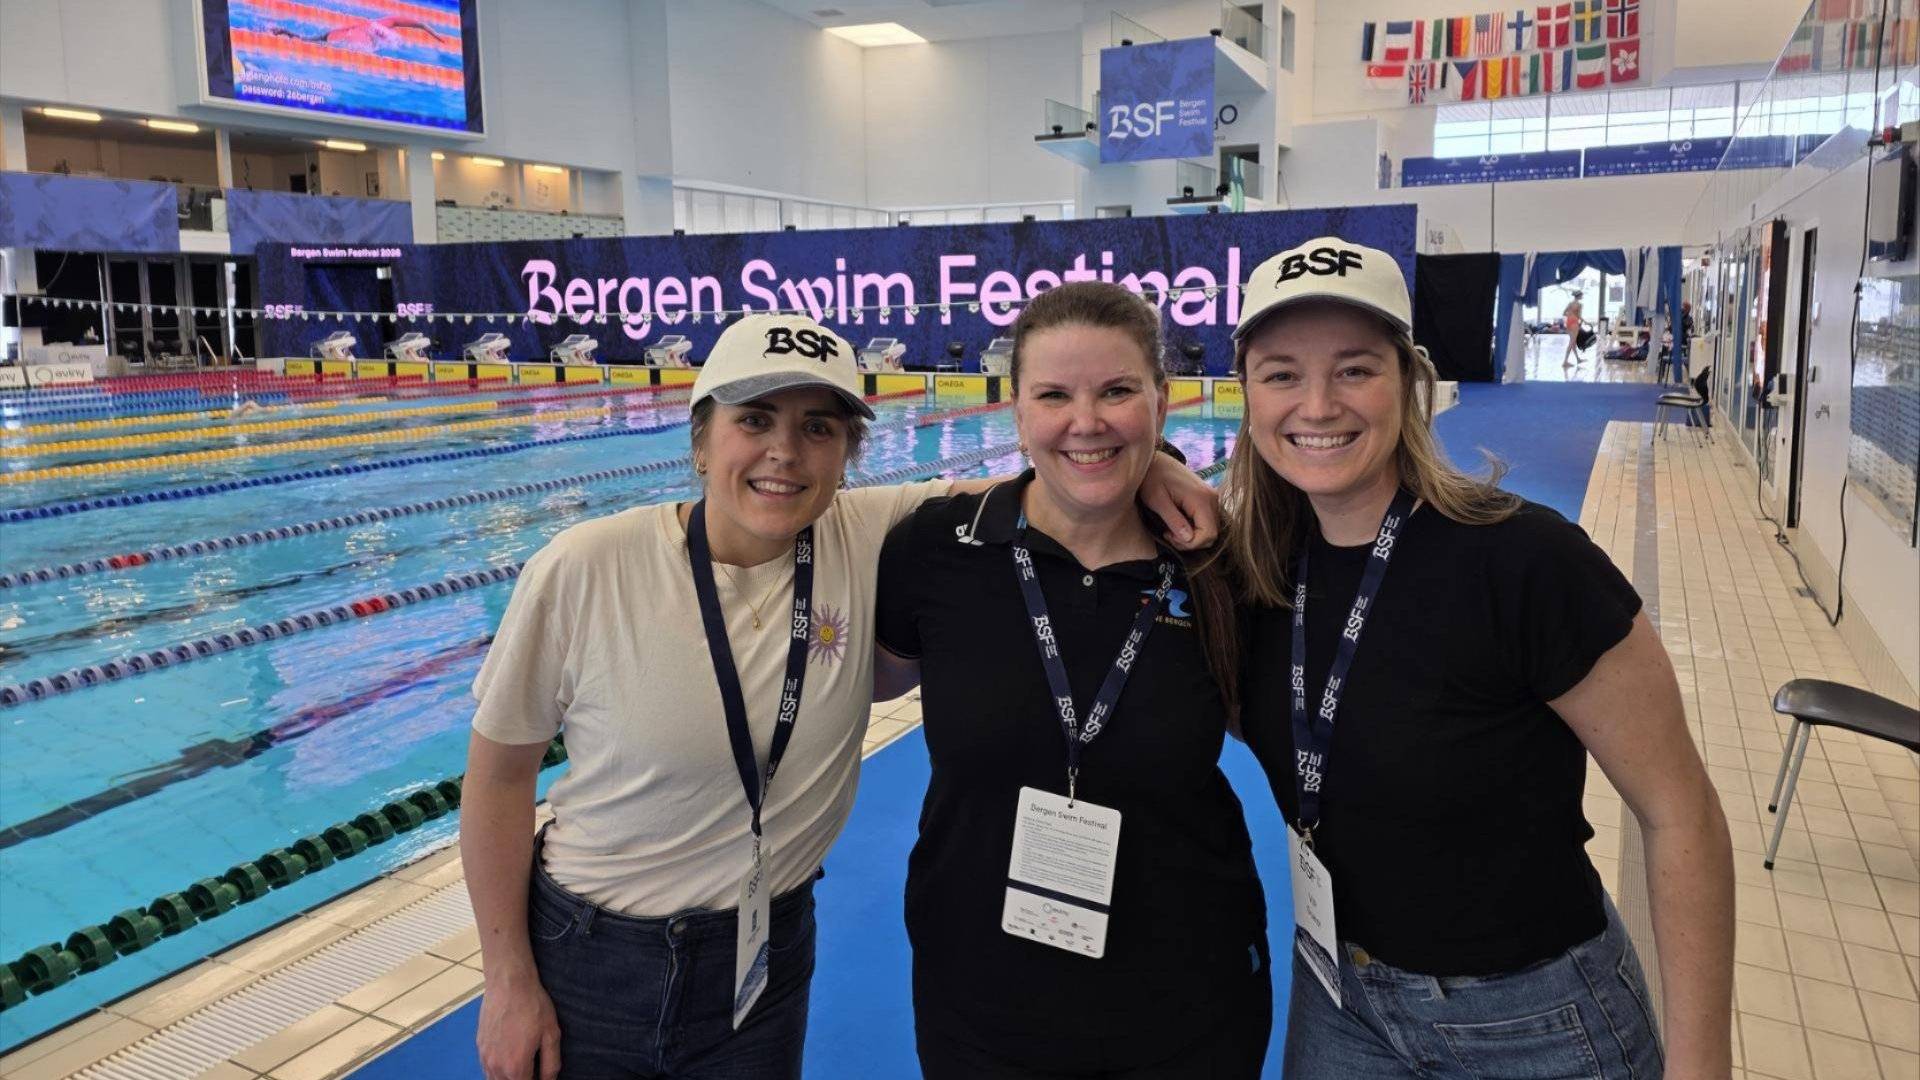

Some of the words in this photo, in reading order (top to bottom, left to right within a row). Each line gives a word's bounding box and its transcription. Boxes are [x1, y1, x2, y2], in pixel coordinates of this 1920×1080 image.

[1108, 100, 1176, 139] BSF
[1179, 98, 1207, 109] Bergen
[1179, 108, 1201, 118] Swim
[1179, 117, 1208, 127] Festival
[291, 247, 322, 259] Bergen
[323, 248, 347, 258] Swim
[348, 248, 380, 258] Festival
[1274, 247, 1363, 290] BSF
[397, 303, 425, 317] BSF
[520, 258, 724, 340] Bergen
[740, 256, 915, 326] Swim
[763, 327, 839, 362] BSF
[938, 380, 964, 388] OMEGA
[1218, 386, 1243, 394] OMEG
[1373, 524, 1397, 561] BSF
[793, 608, 809, 640] BSF
[1032, 615, 1056, 651] BSF
[1344, 605, 1366, 643] BSF
[1115, 635, 1140, 674] BSF
[780, 691, 800, 724] BSF
[1056, 696, 1077, 728] BSF
[1320, 685, 1340, 723] BSF
[1079, 711, 1103, 744] BSF
[1304, 764, 1322, 793] BSF
